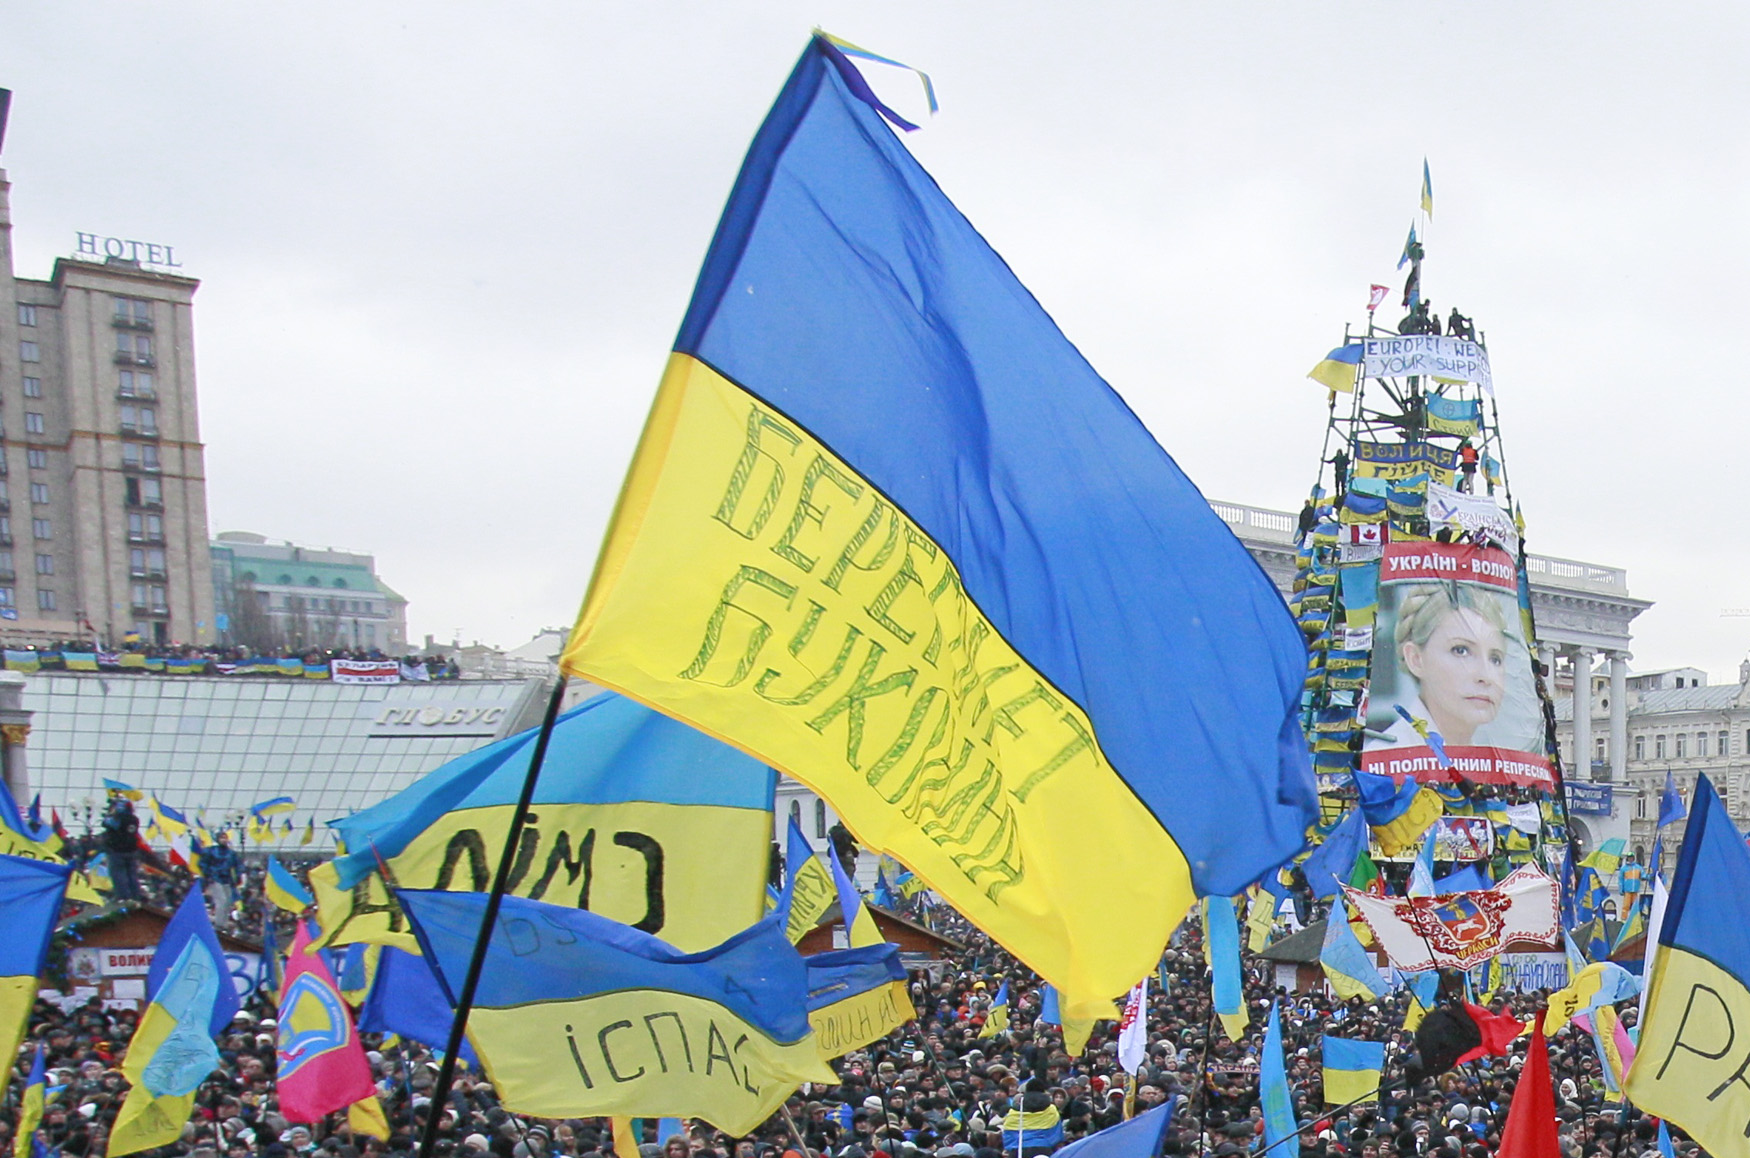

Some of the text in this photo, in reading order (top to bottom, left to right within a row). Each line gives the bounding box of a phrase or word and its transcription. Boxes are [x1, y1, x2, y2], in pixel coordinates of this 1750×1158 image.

[76, 231, 182, 267] HOTEL
[1381, 354, 1425, 374] YOUR
[1389, 553, 1457, 572] УКРАЇНІ
[1472, 558, 1513, 581] ВОЛЮ!
